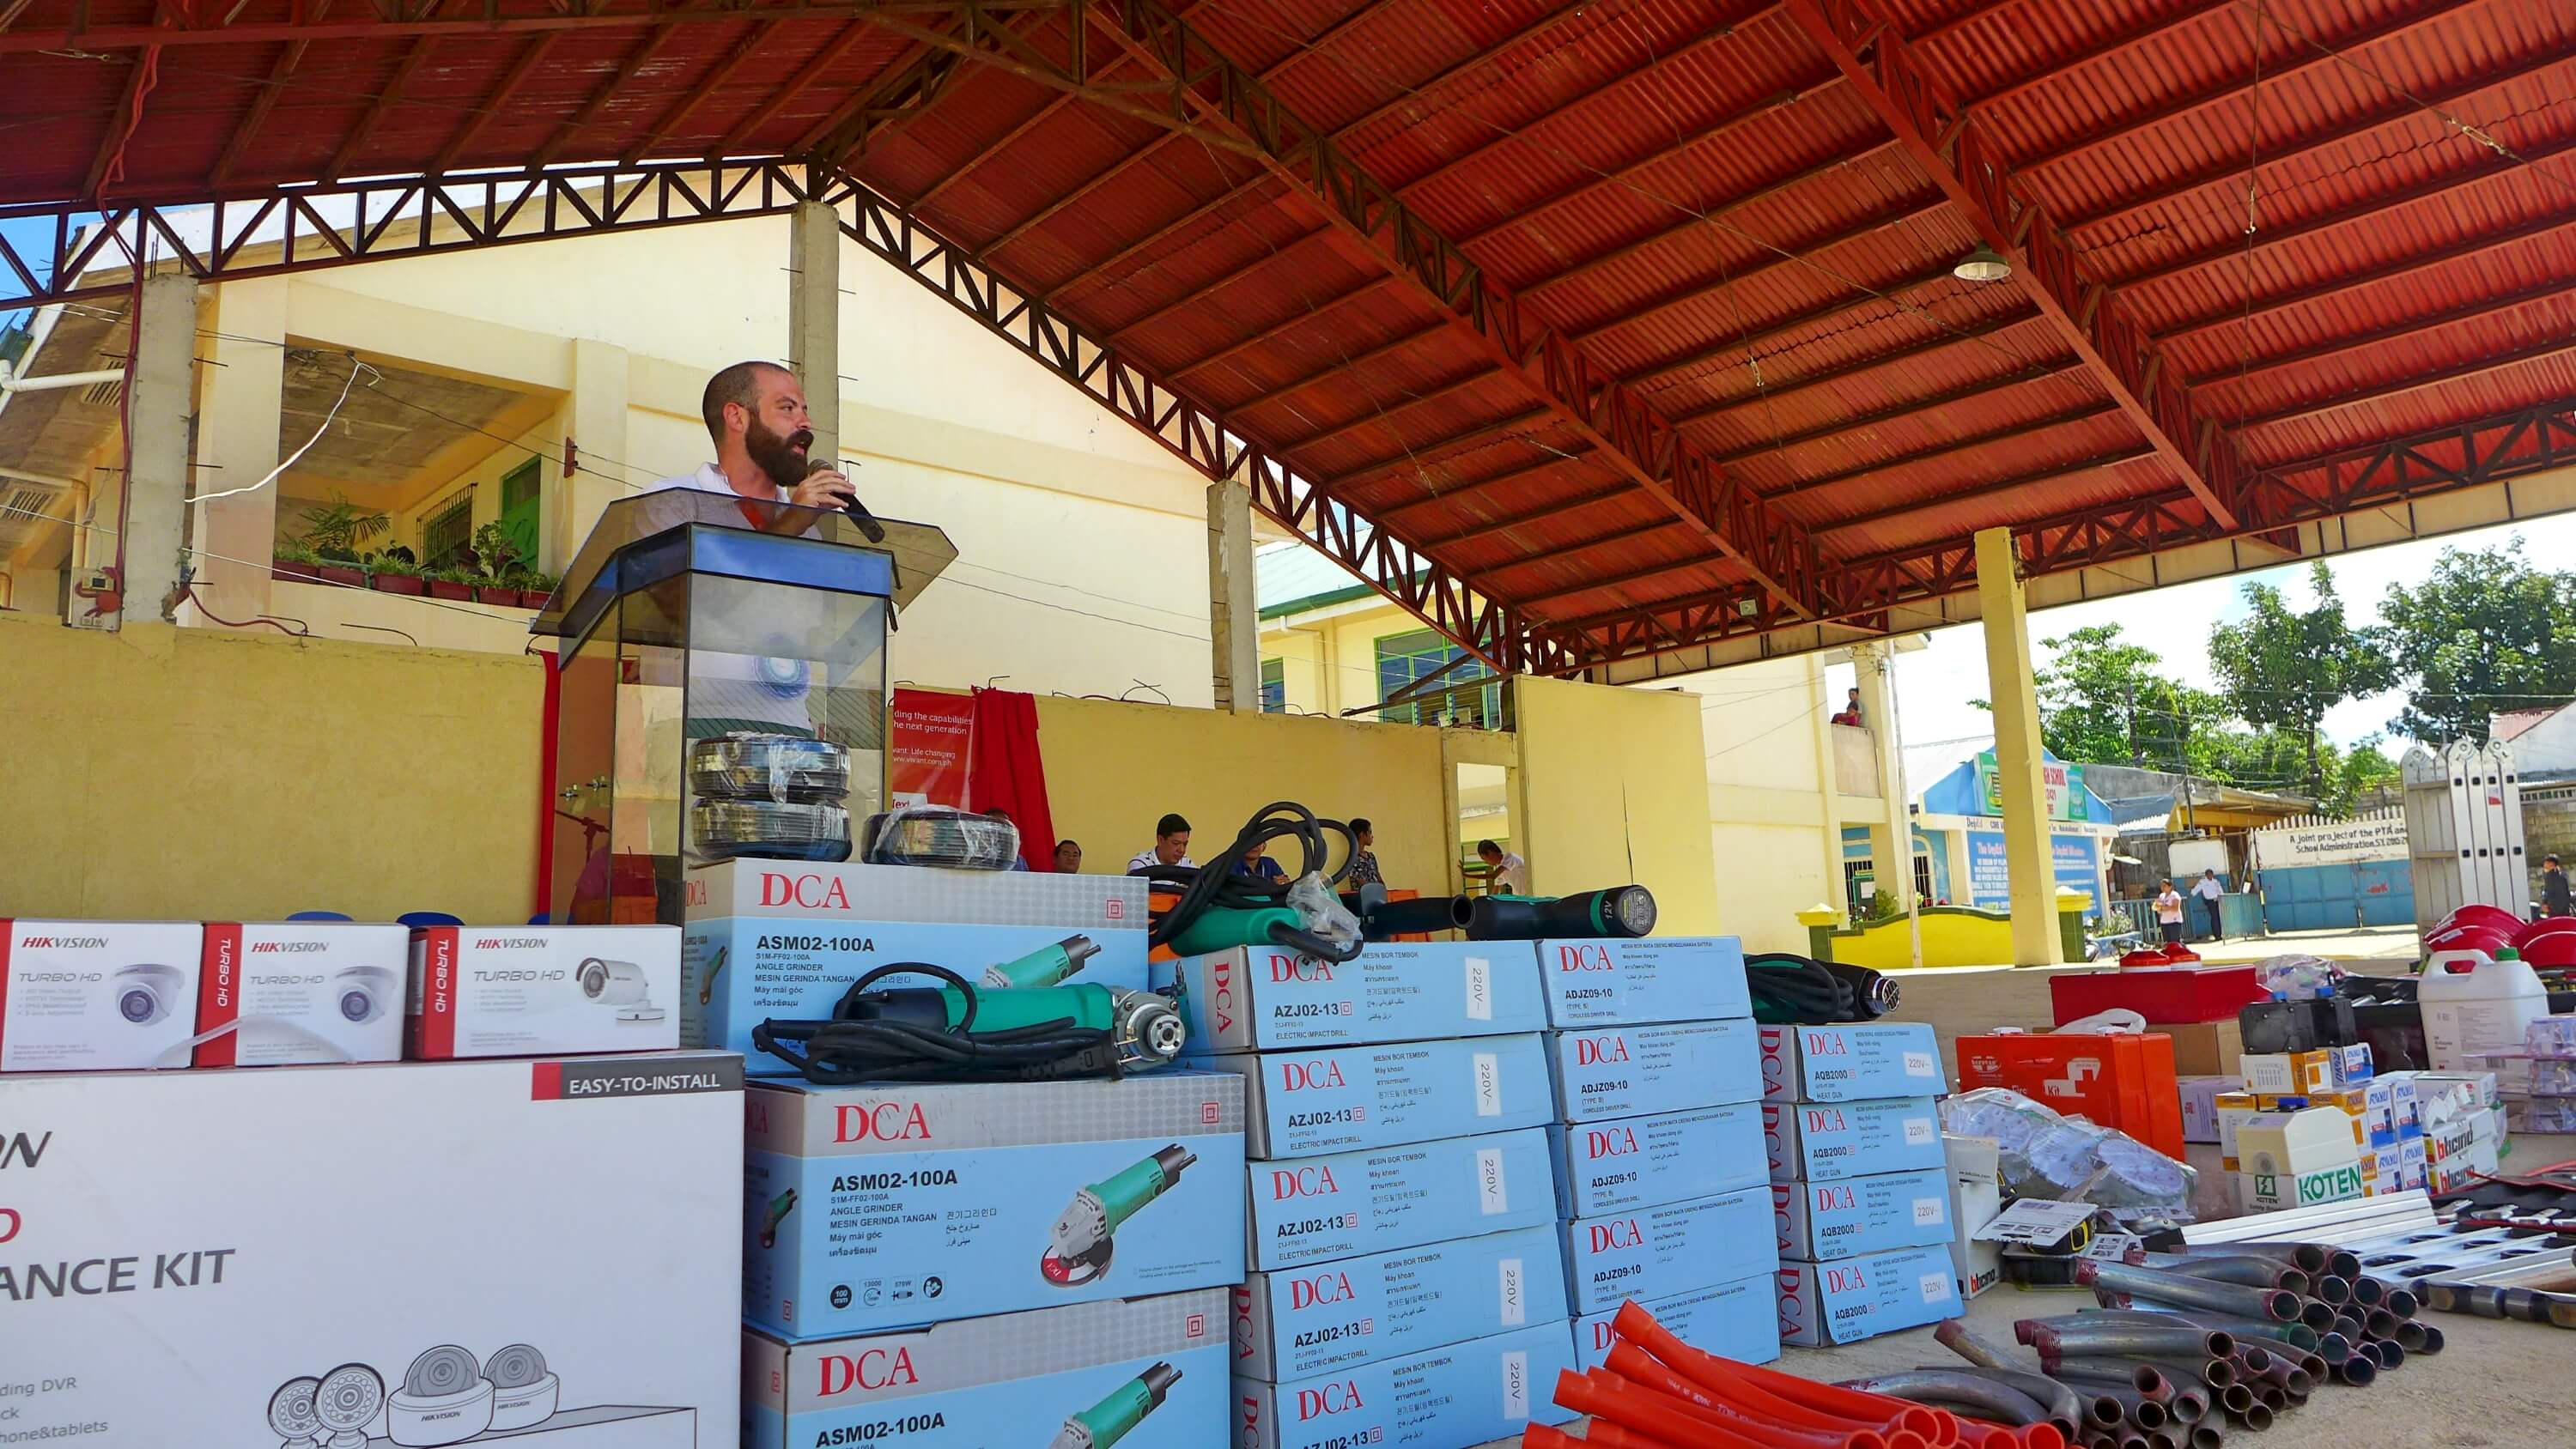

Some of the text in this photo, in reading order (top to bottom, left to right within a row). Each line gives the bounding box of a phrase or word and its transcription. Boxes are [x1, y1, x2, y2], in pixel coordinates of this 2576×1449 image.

[929, 713, 974, 725] capabilities
[924, 724, 967, 736] generation
[925, 749, 956, 759] changing
[2360, 828, 2373, 837] the
[2295, 843, 2318, 853] School
[758, 872, 852, 909] DCA
[1604, 900, 1613, 919] 12V
[22, 937, 109, 949] HIKVISION
[252, 942, 329, 953] HIKVISION
[475, 938, 549, 949] HIKVISION
[756, 936, 876, 952] ASM02-100A
[786, 963, 823, 972] GRINDER
[1558, 945, 1614, 972] DCA
[19, 973, 103, 983] TURBO HD
[217, 937, 232, 1008] TURBO HD
[434, 939, 449, 1013] TURBO HD
[474, 970, 565, 981] TURBO HD
[1269, 955, 1334, 983] DCA
[250, 975, 325, 985] TURBO HD
[755, 974, 855, 984] MESIN GERINDA TANGAN
[1214, 961, 1233, 1034] DCA
[1565, 988, 1613, 1000] ADJZ09-10
[1274, 1003, 1339, 1018] AZJ02-13
[1577, 1036, 1630, 1066] DCA
[1808, 1033, 1847, 1056] DCA
[1761, 1028, 1783, 1097] DCA
[569, 1073, 720, 1094] EASY-TO-INSTALL
[1281, 1059, 1347, 1092] DCA
[1814, 1070, 1848, 1082] AQB2000
[1581, 1080, 1628, 1094] ADJZ09-10
[832, 1102, 932, 1143] DCA
[1288, 1108, 1352, 1128] AZJ02-13
[1807, 1109, 1847, 1133] DCA
[1290, 1135, 1362, 1150] ELECTRIC IMPACT DRILL
[1587, 1126, 1639, 1159] DCA
[1762, 1105, 1783, 1171] DCA
[1368, 1152, 1427, 1166] MESIN BOR TEMBOK
[1813, 1147, 1847, 1159] AQB2000
[831, 1169, 958, 1192] ASM02-100A
[1271, 1166, 1340, 1201] DCA
[1591, 1172, 1637, 1188] ADJZ09-10
[2298, 1161, 2361, 1203] KOTEN
[1817, 1185, 1856, 1211] DCA
[830, 1203, 903, 1216] ANGLE GRINDER
[1772, 1183, 1792, 1251] DCA
[829, 1213, 937, 1229] MESIN GERINDA TANGAN
[1277, 1216, 1344, 1238] AZJ02-13
[1589, 1219, 1643, 1254] DCA
[1820, 1224, 1855, 1238] AQB2000
[1279, 1243, 1354, 1261] ELECTRIC IMPACT DRILL
[1417, 1252, 1442, 1264] TEMBOK
[153, 1248, 236, 1289] KIT
[1594, 1264, 1643, 1283] ADJZ09-10
[1826, 1265, 1867, 1294] DCA
[1290, 1271, 1355, 1311] DCA
[1778, 1267, 1802, 1339] DCA
[1834, 1304, 1868, 1320] AQB2000
[1236, 1288, 1255, 1361] DCA
[1294, 1322, 1360, 1348] AZJ02-13
[1296, 1359, 1327, 1372] ELECTRIC
[1327, 1354, 1350, 1366] IMPACT
[1350, 1349, 1369, 1361] DRILL
[1413, 1357, 1453, 1372] BOR TEMBOK
[817, 1346, 919, 1397] DCA
[41, 1377, 77, 1392] DVR
[1297, 1379, 1364, 1422] DCA
[0, 1407, 20, 1420] ck
[816, 1412, 945, 1449] ASM02-100A
[1303, 1430, 1369, 1449] J02-13
